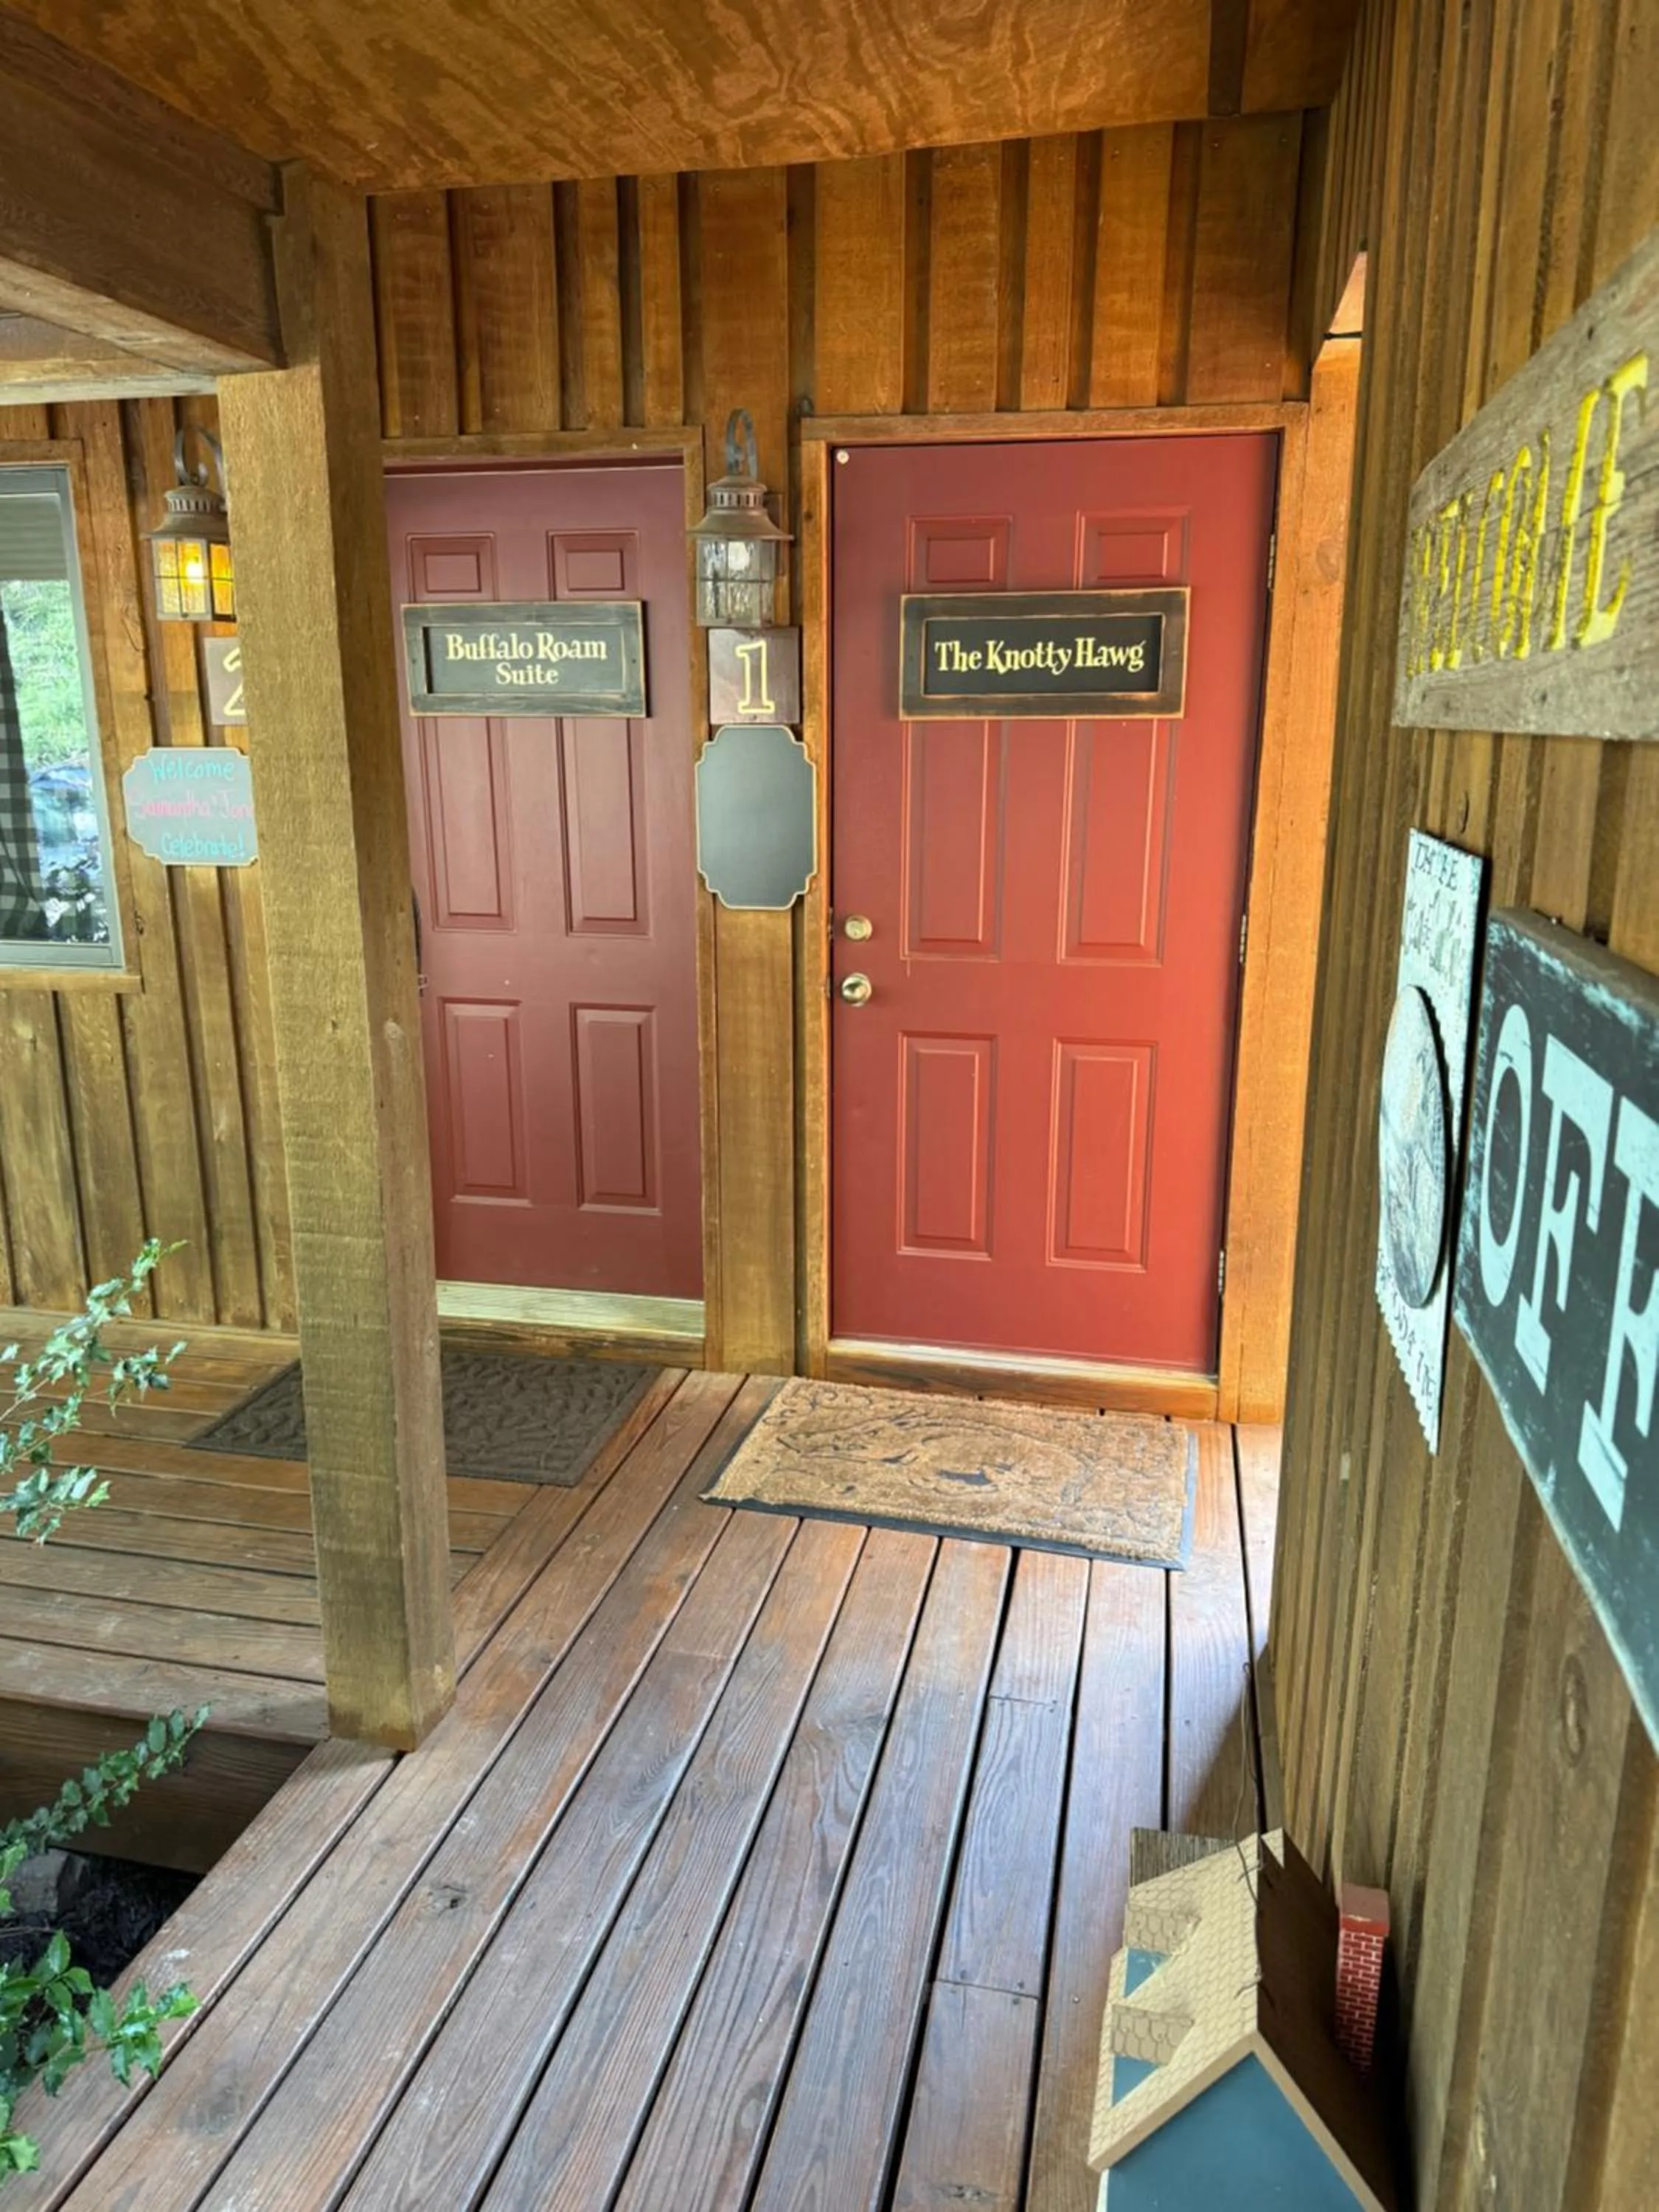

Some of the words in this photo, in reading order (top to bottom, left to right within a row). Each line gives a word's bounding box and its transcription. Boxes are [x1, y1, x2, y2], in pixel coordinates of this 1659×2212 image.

[445, 633, 534, 661] Buffalo
[535, 632, 608, 662] Roam
[934, 640, 982, 672] The
[986, 639, 1072, 675] Knotty
[1074, 636, 1147, 673] Hawg
[495, 662, 560, 686] Suite
[736, 640, 775, 714] 1
[148, 754, 235, 784] Welcome
